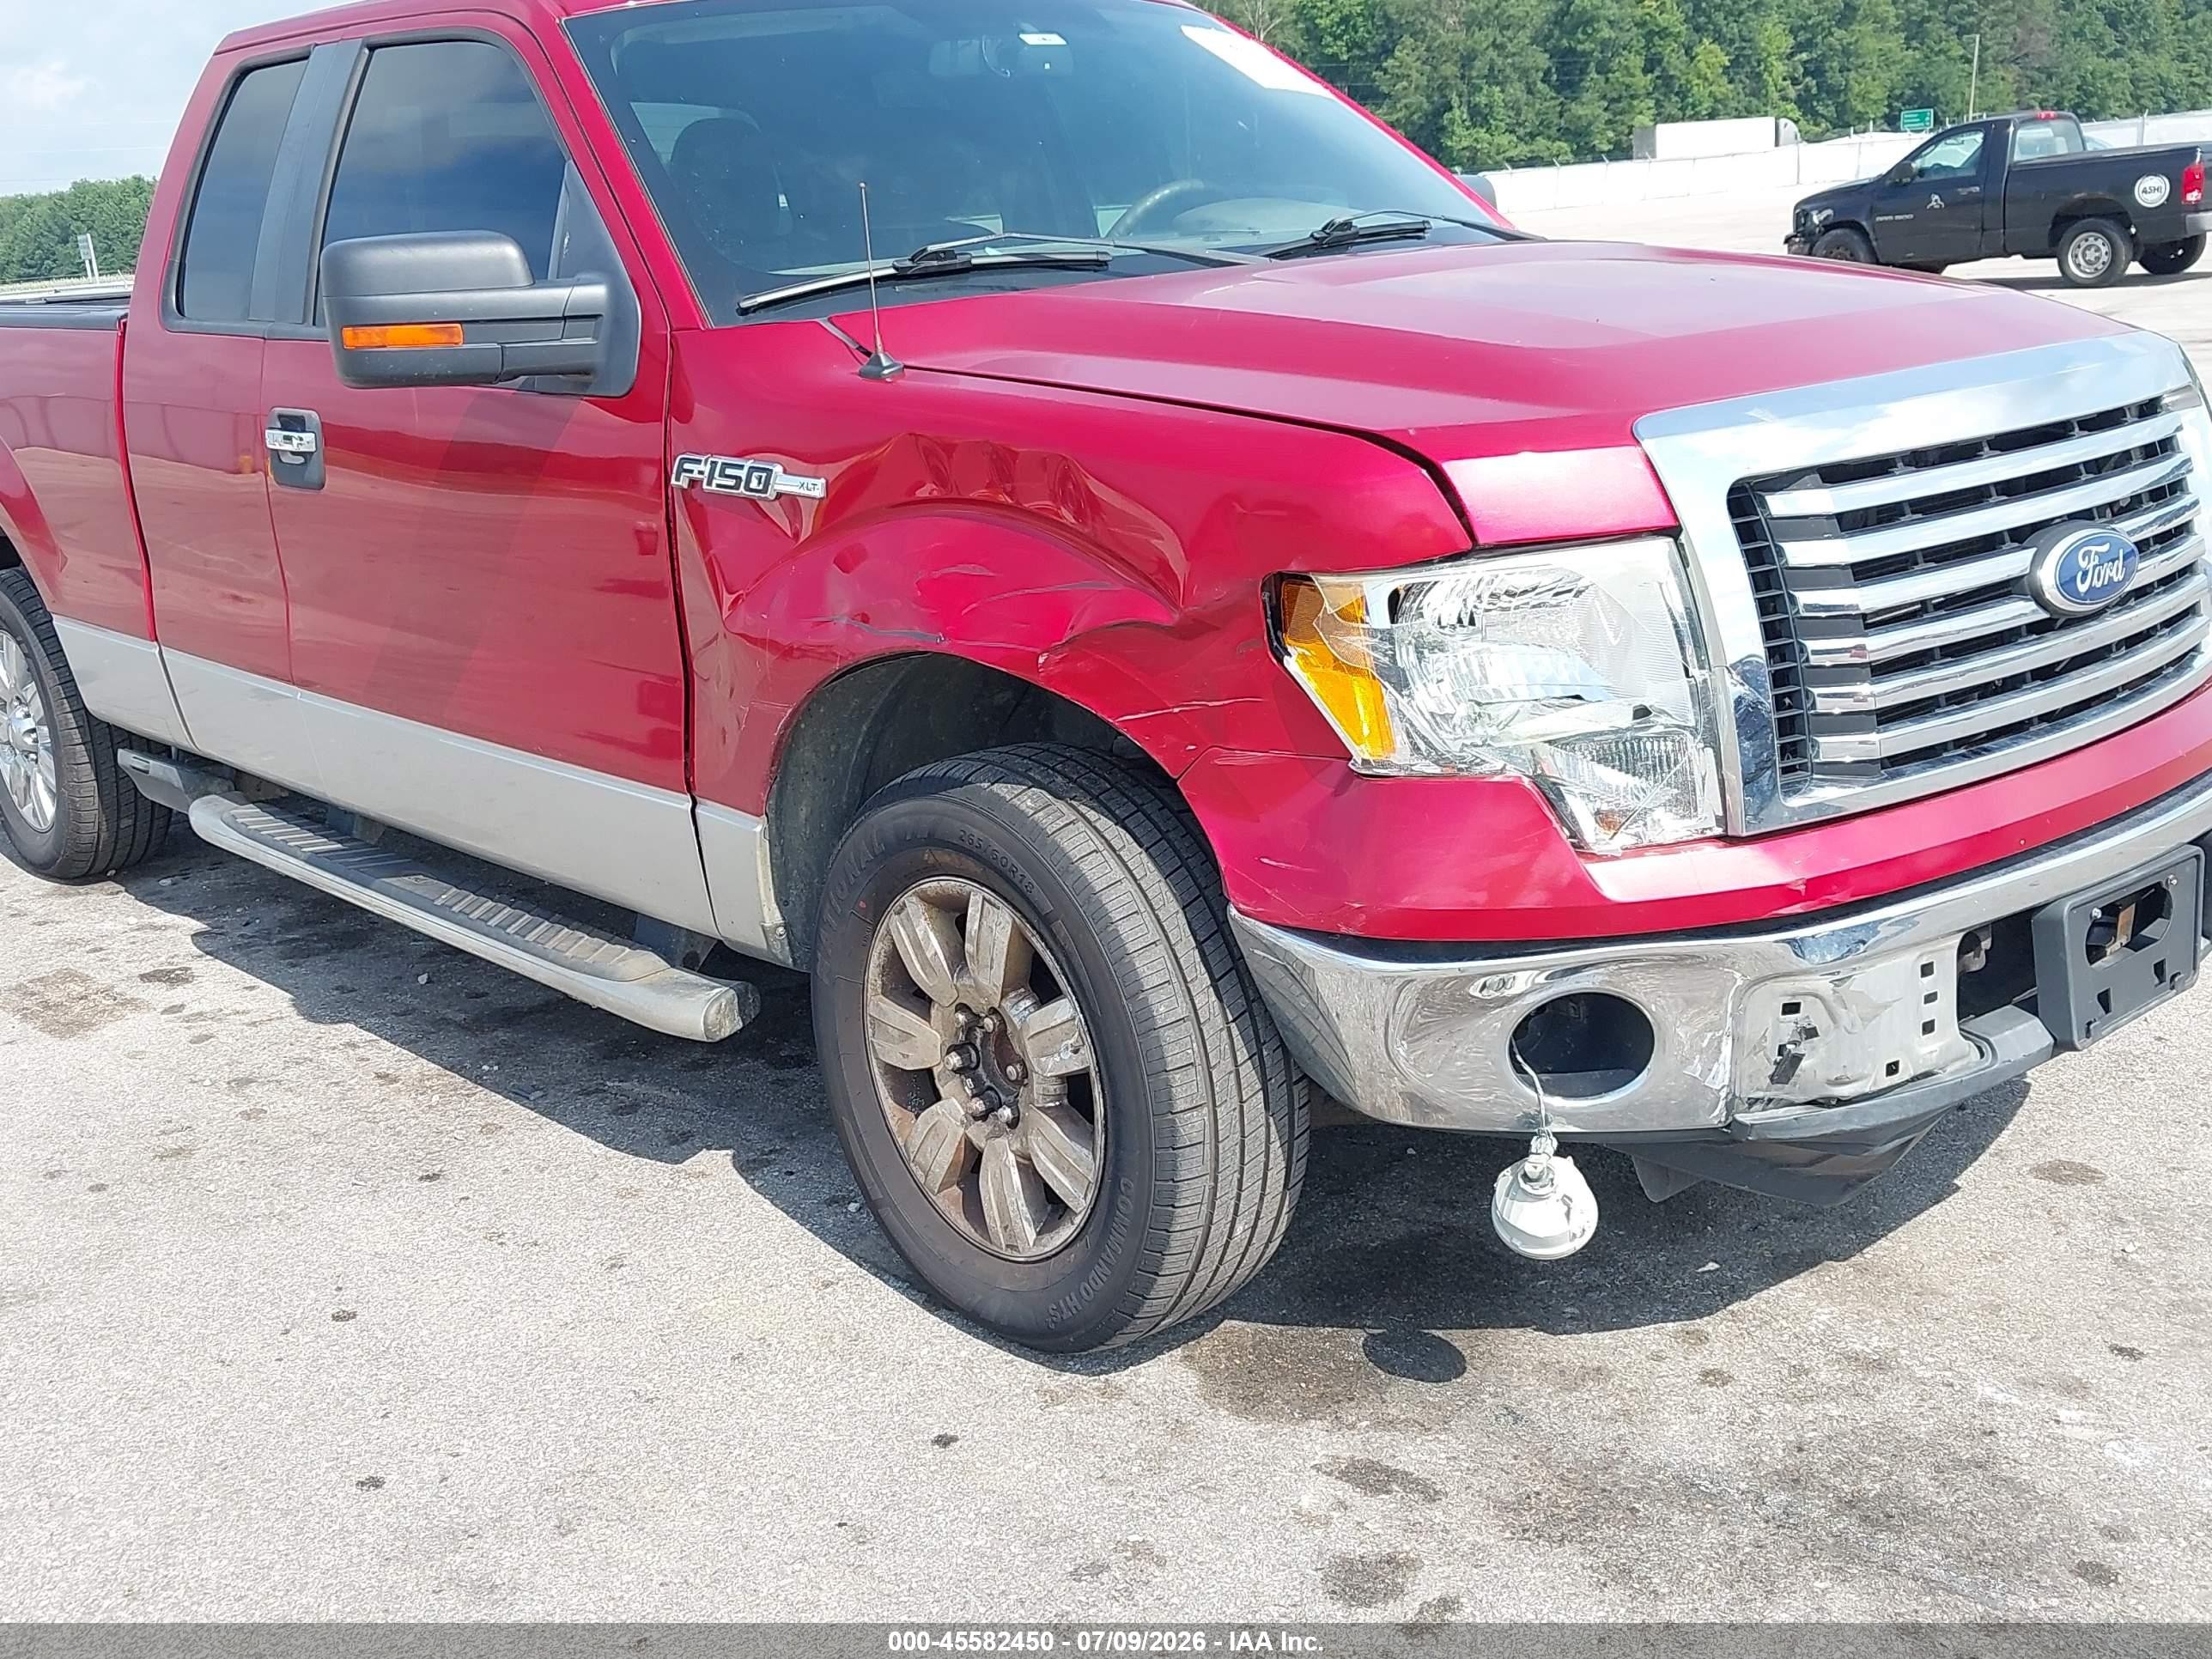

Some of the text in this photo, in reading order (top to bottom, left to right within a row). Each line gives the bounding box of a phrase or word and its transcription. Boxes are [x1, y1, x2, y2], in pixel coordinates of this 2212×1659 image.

[672, 454, 818, 498] F-150 XLT
[2075, 542, 2126, 596] Ford
[958, 829, 1036, 895] 265/60R18
[1079, 1177, 1135, 1303] COMMANDO
